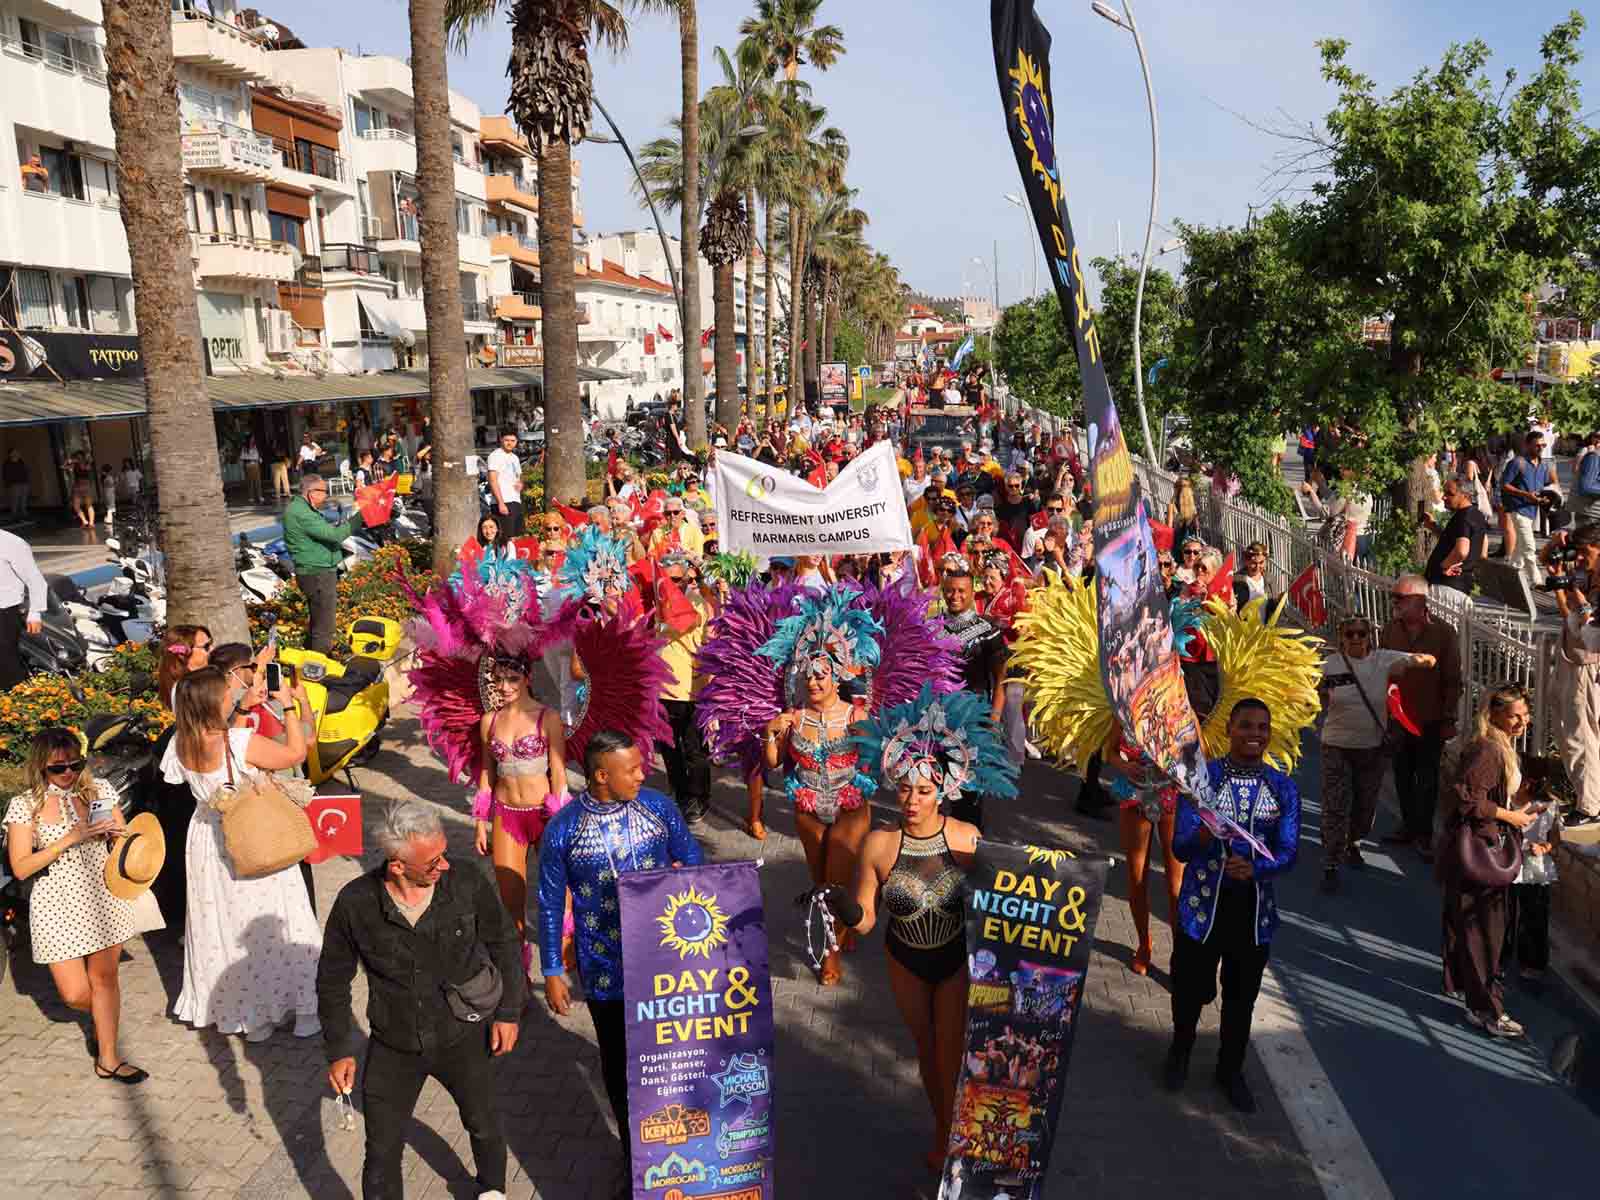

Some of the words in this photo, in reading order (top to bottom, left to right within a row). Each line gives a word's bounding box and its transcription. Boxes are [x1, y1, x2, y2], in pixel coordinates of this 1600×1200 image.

[89, 349, 139, 371] TATTOO
[730, 509, 814, 525] REFRESHMENT
[818, 502, 886, 525] UNIVERSITY
[752, 532, 815, 544] MARMARIS
[818, 528, 870, 543] CAMPUS
[972, 889, 1056, 925] NIGHT
[993, 870, 1061, 901] DAY
[1058, 886, 1087, 933] &
[983, 917, 1078, 957] EVENT
[654, 968, 719, 996] DAY
[724, 966, 759, 1009] &
[637, 993, 720, 1022] NIGHT
[656, 1011, 752, 1045] EVENT
[640, 1048, 708, 1063] Organizasyon,
[723, 1071, 763, 1086] MICHAEL
[725, 1080, 765, 1095] JACKSON
[644, 1122, 688, 1140] KENYA
